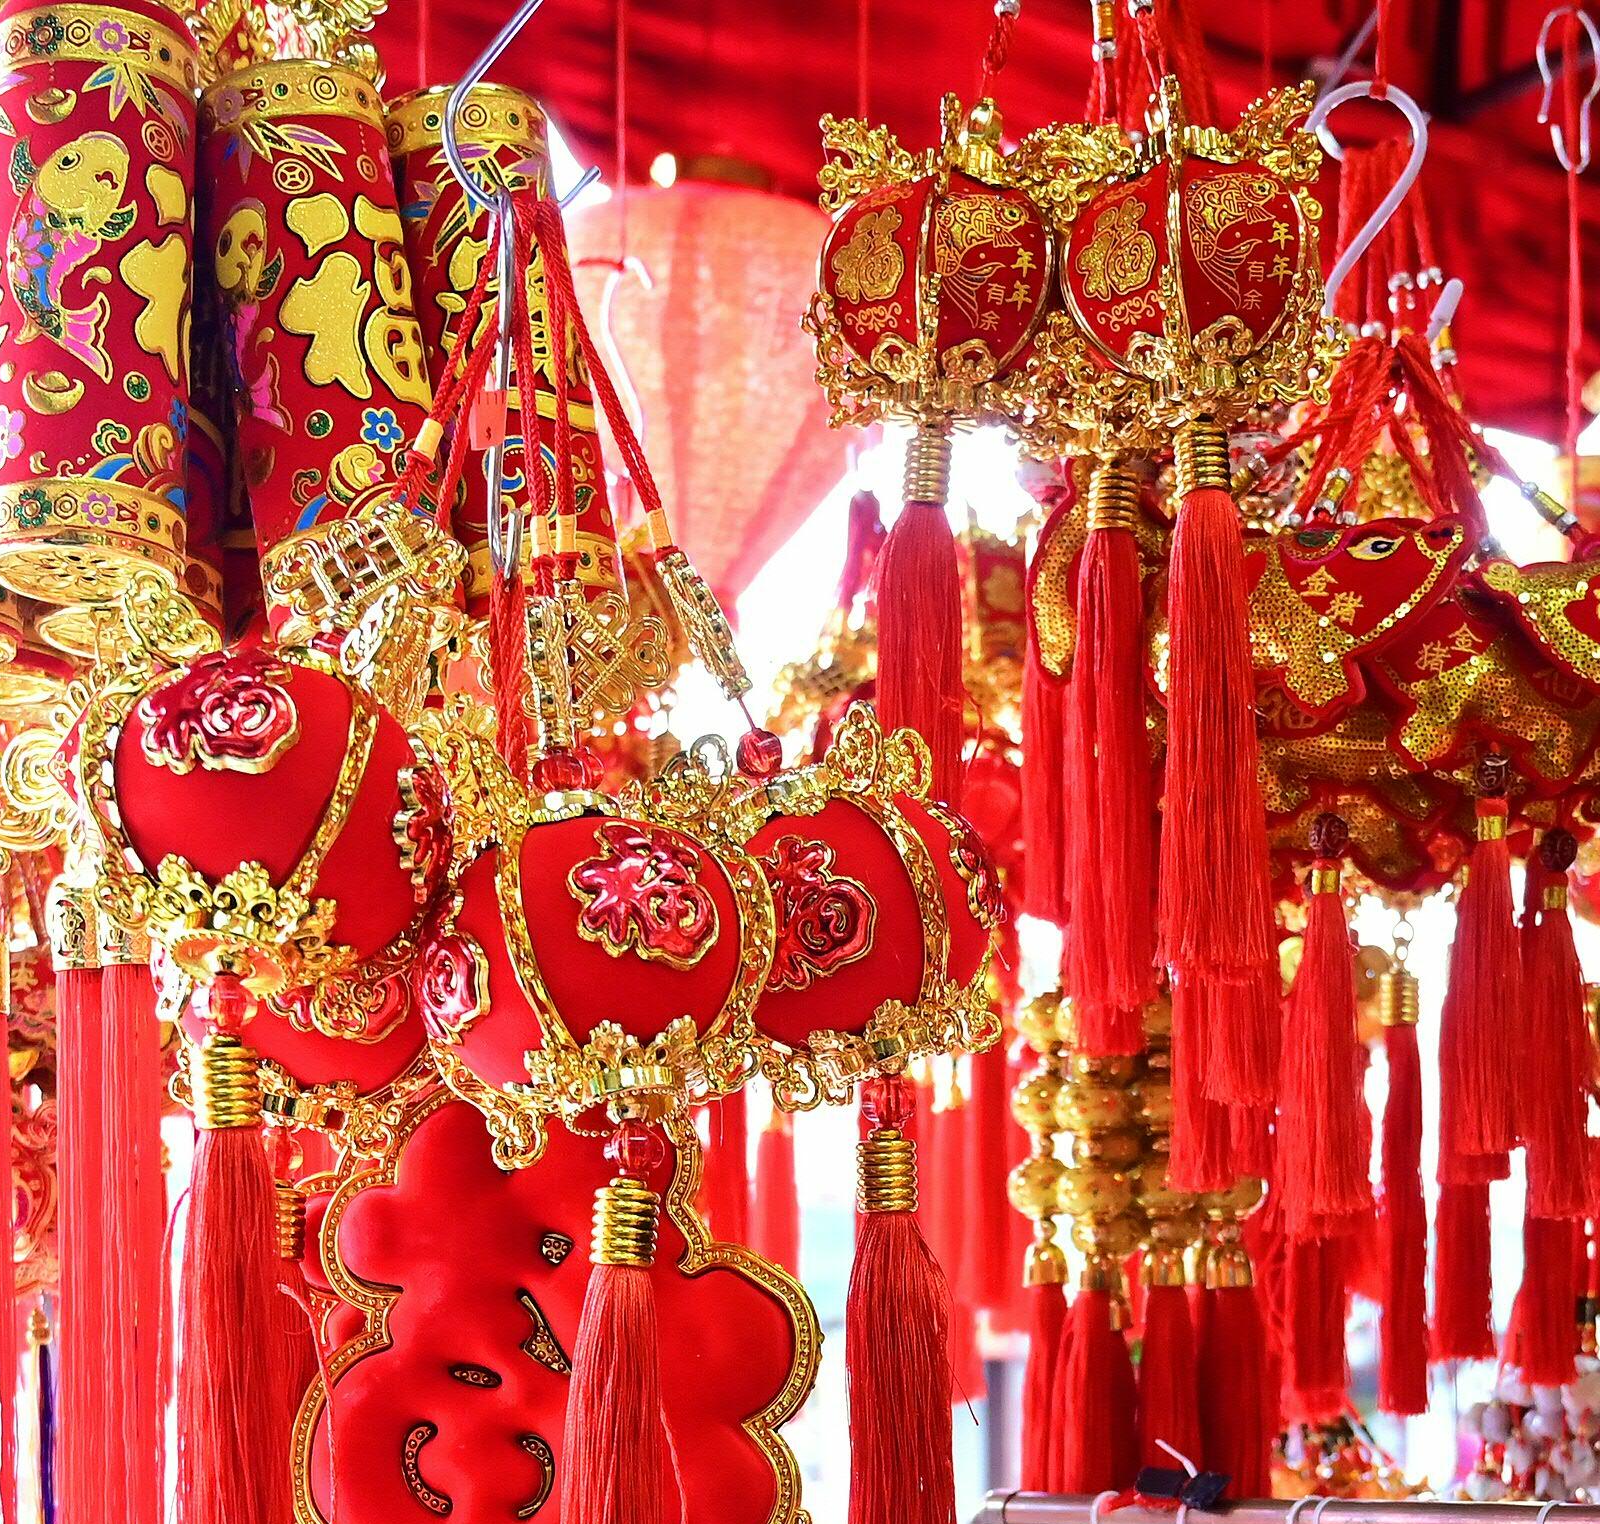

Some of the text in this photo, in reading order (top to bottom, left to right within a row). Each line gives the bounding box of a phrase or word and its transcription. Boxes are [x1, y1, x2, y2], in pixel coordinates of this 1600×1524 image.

[831, 205, 904, 305] 福
[1005, 247, 1038, 312] 年年
[1077, 196, 1156, 301] 福
[1266, 221, 1296, 286] 年年
[980, 282, 1006, 331] 有余
[1243, 260, 1265, 311] 有余
[1300, 565, 1364, 627] 金猪
[1417, 622, 1483, 671] 金猪
